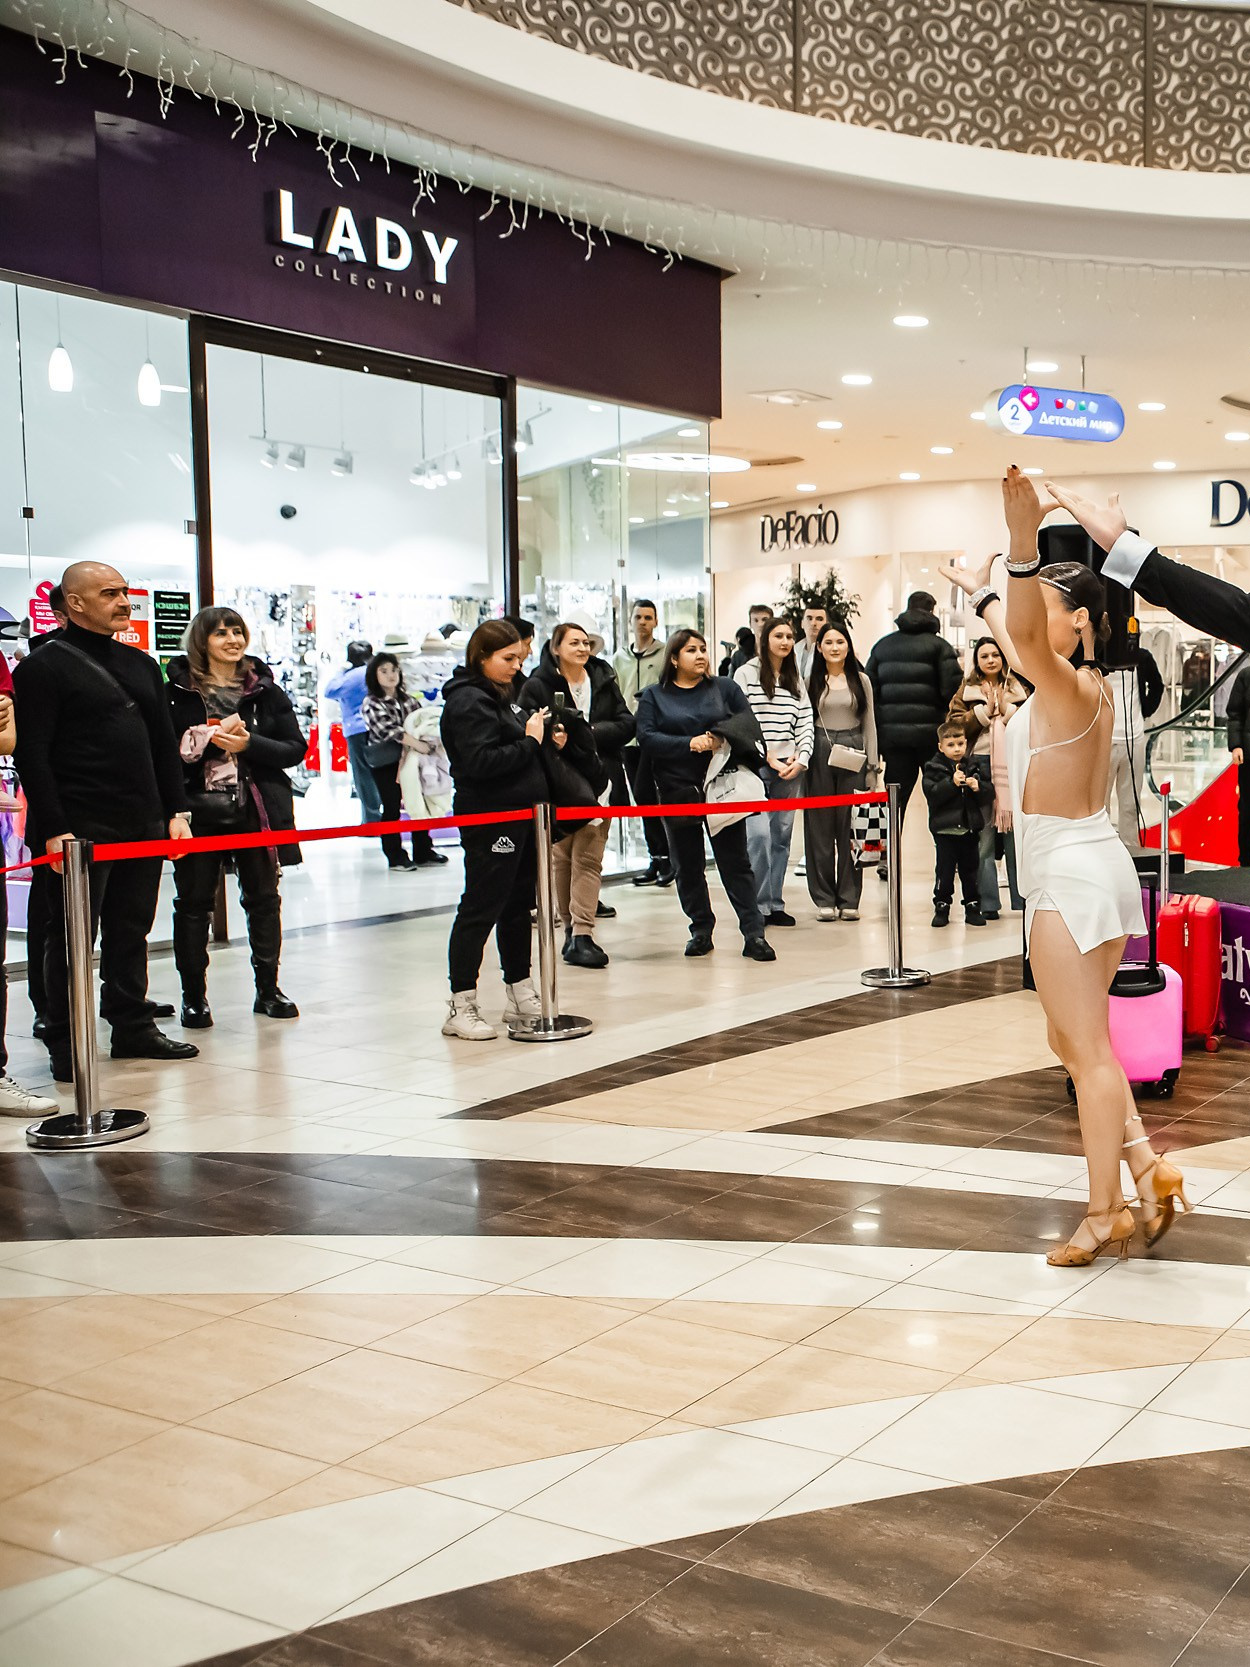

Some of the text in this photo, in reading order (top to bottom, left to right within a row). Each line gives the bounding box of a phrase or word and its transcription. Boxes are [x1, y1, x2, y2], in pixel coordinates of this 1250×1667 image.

[279, 188, 458, 285] LADY
[274, 254, 442, 305] COLLECTION
[1039, 411, 1087, 429] Детский
[760, 503, 839, 552] DeFacto
[119, 633, 141, 643] RED
